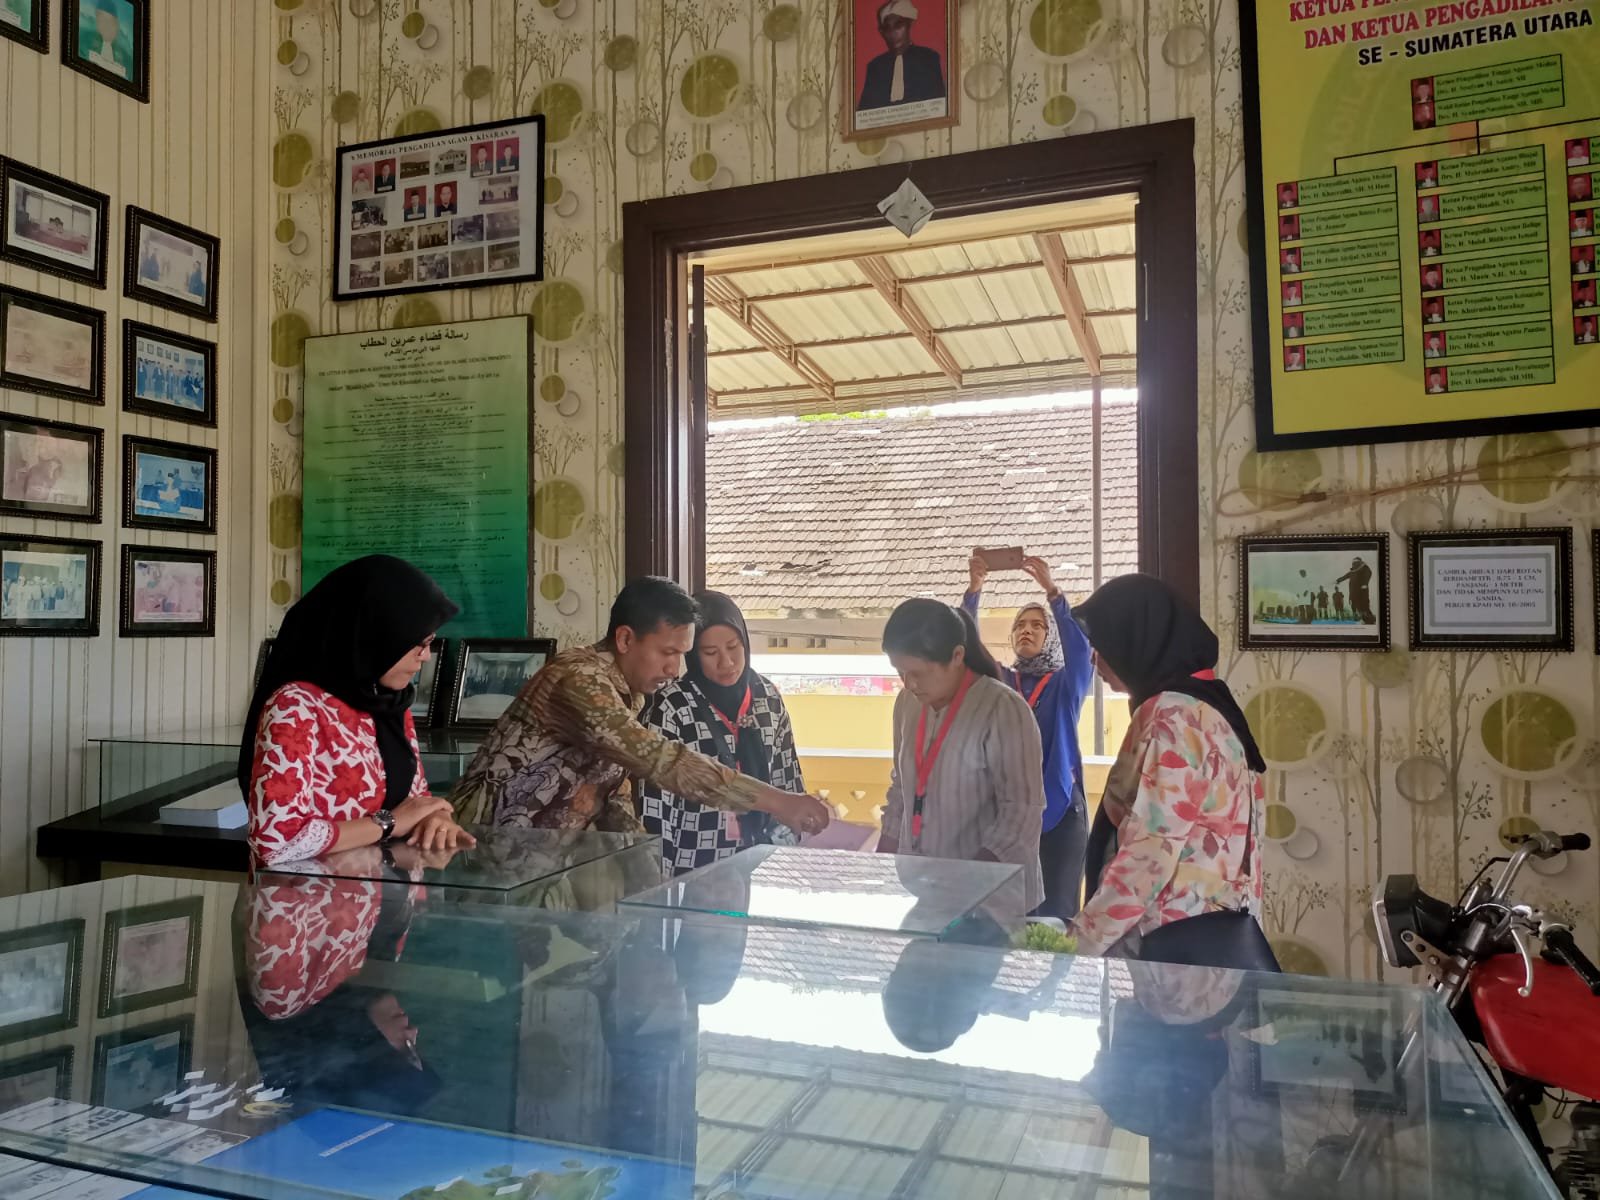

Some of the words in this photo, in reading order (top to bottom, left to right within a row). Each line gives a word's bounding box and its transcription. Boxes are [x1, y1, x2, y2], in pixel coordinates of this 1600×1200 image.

[1289, 0, 1359, 21] KETUA
[1304, 23, 1347, 49] DAN
[1352, 11, 1420, 42] KETUA
[1425, 0, 1560, 29] PENGADIL
[1358, 47, 1382, 65] SE
[1404, 22, 1517, 58] SUMATERA
[1524, 9, 1593, 36] UTARA
[449, 136, 473, 147] AGAMA
[476, 130, 510, 142] KISARAN
